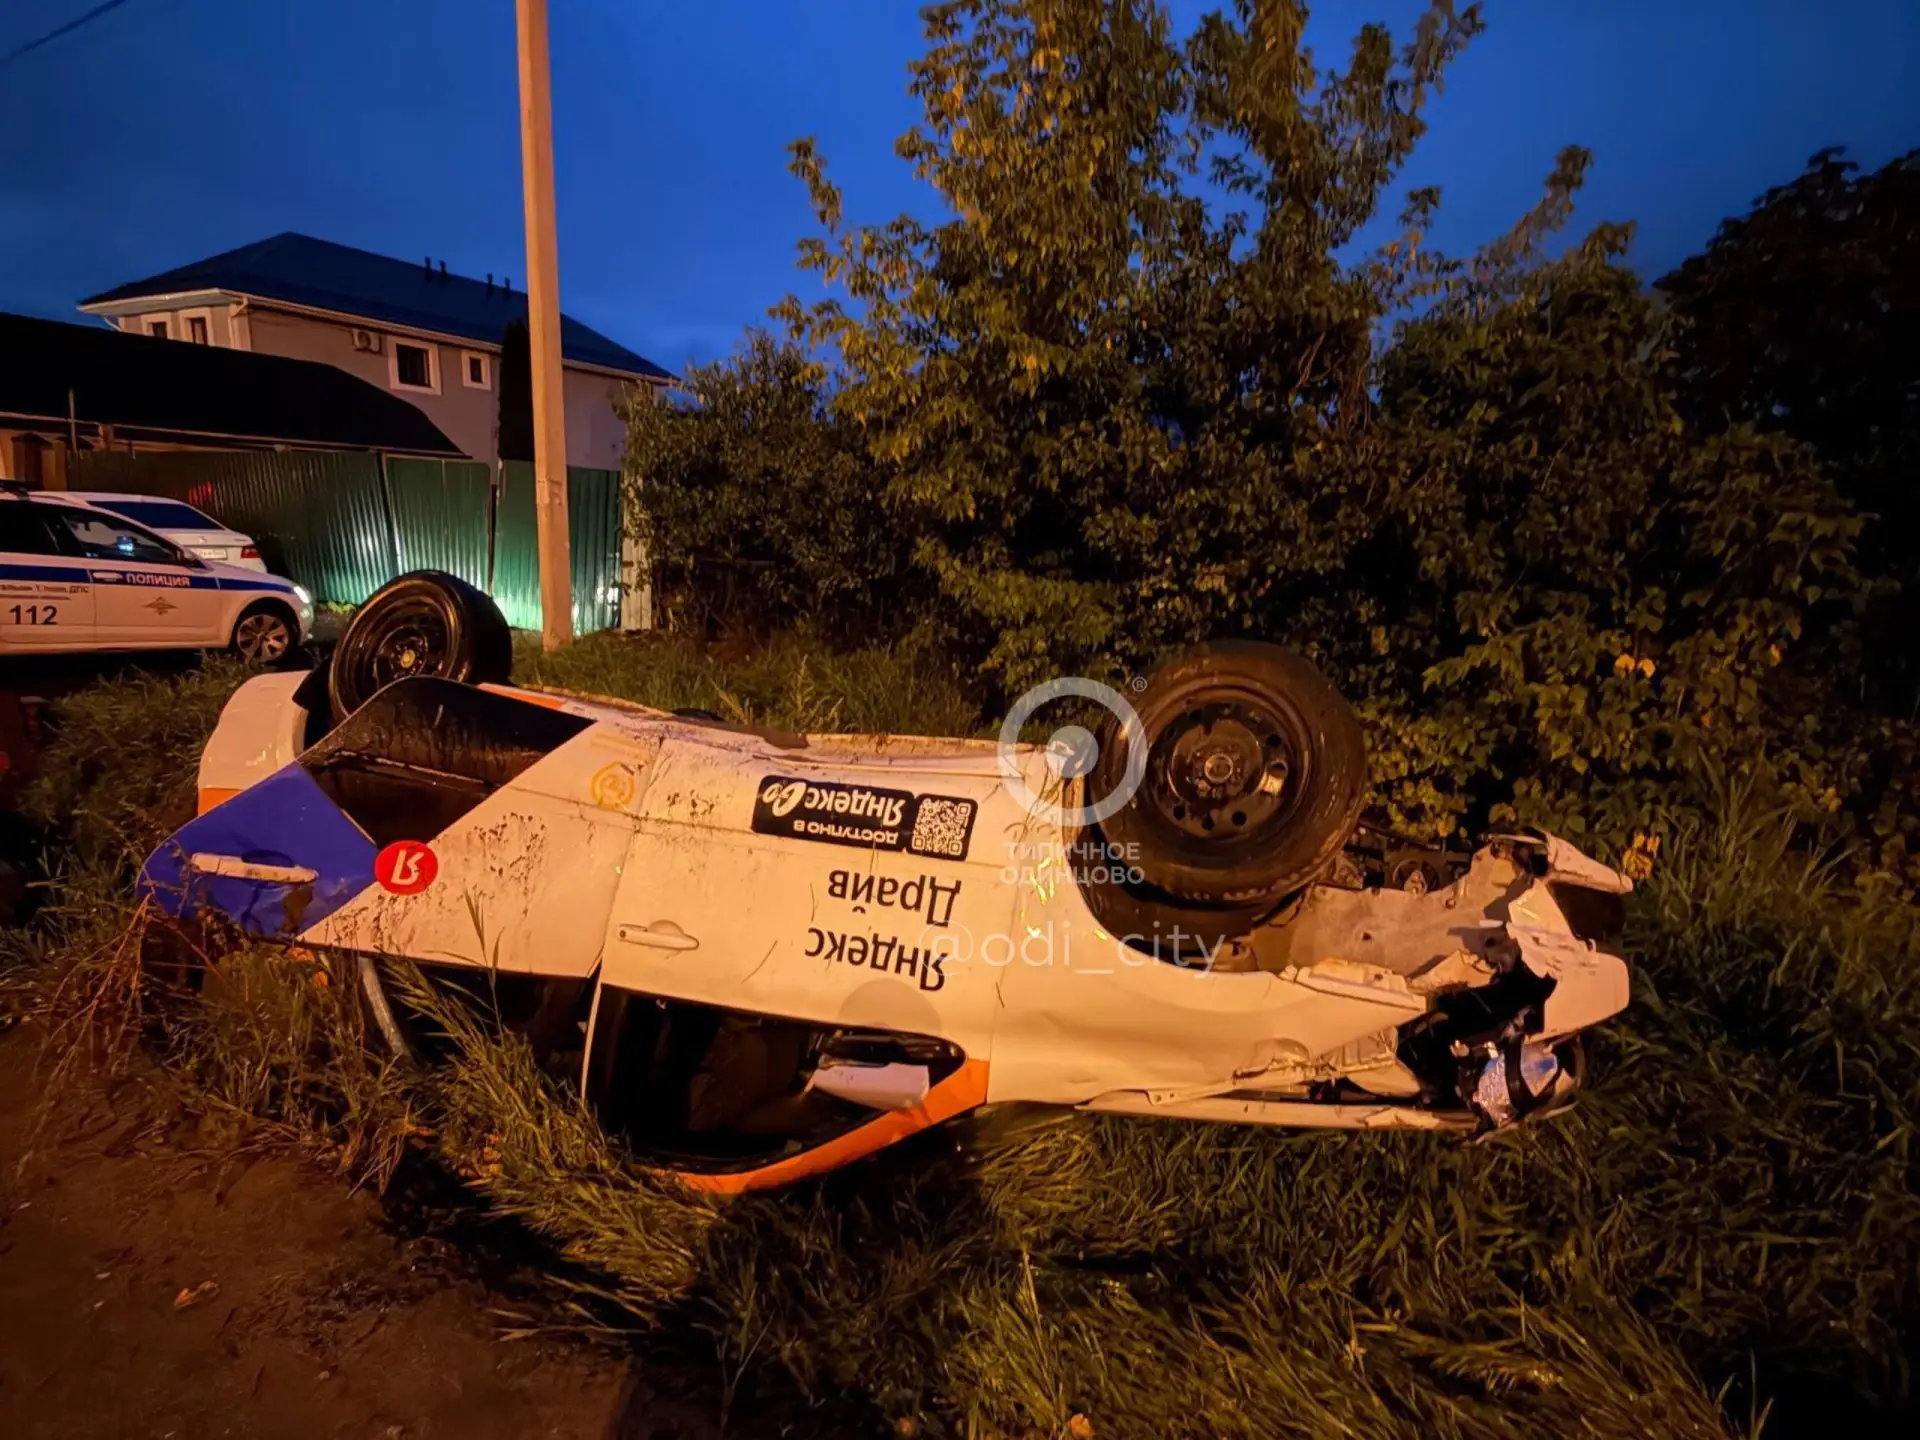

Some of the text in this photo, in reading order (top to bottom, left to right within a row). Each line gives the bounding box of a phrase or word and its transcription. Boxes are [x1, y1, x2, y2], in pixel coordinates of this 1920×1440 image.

[126, 572, 191, 588] ПОЛИЦИЯ
[9, 604, 58, 625] 112
[763, 781, 906, 827] Яндекс Go
[828, 870, 962, 927] Драйв
[804, 928, 949, 992] Яндекс
